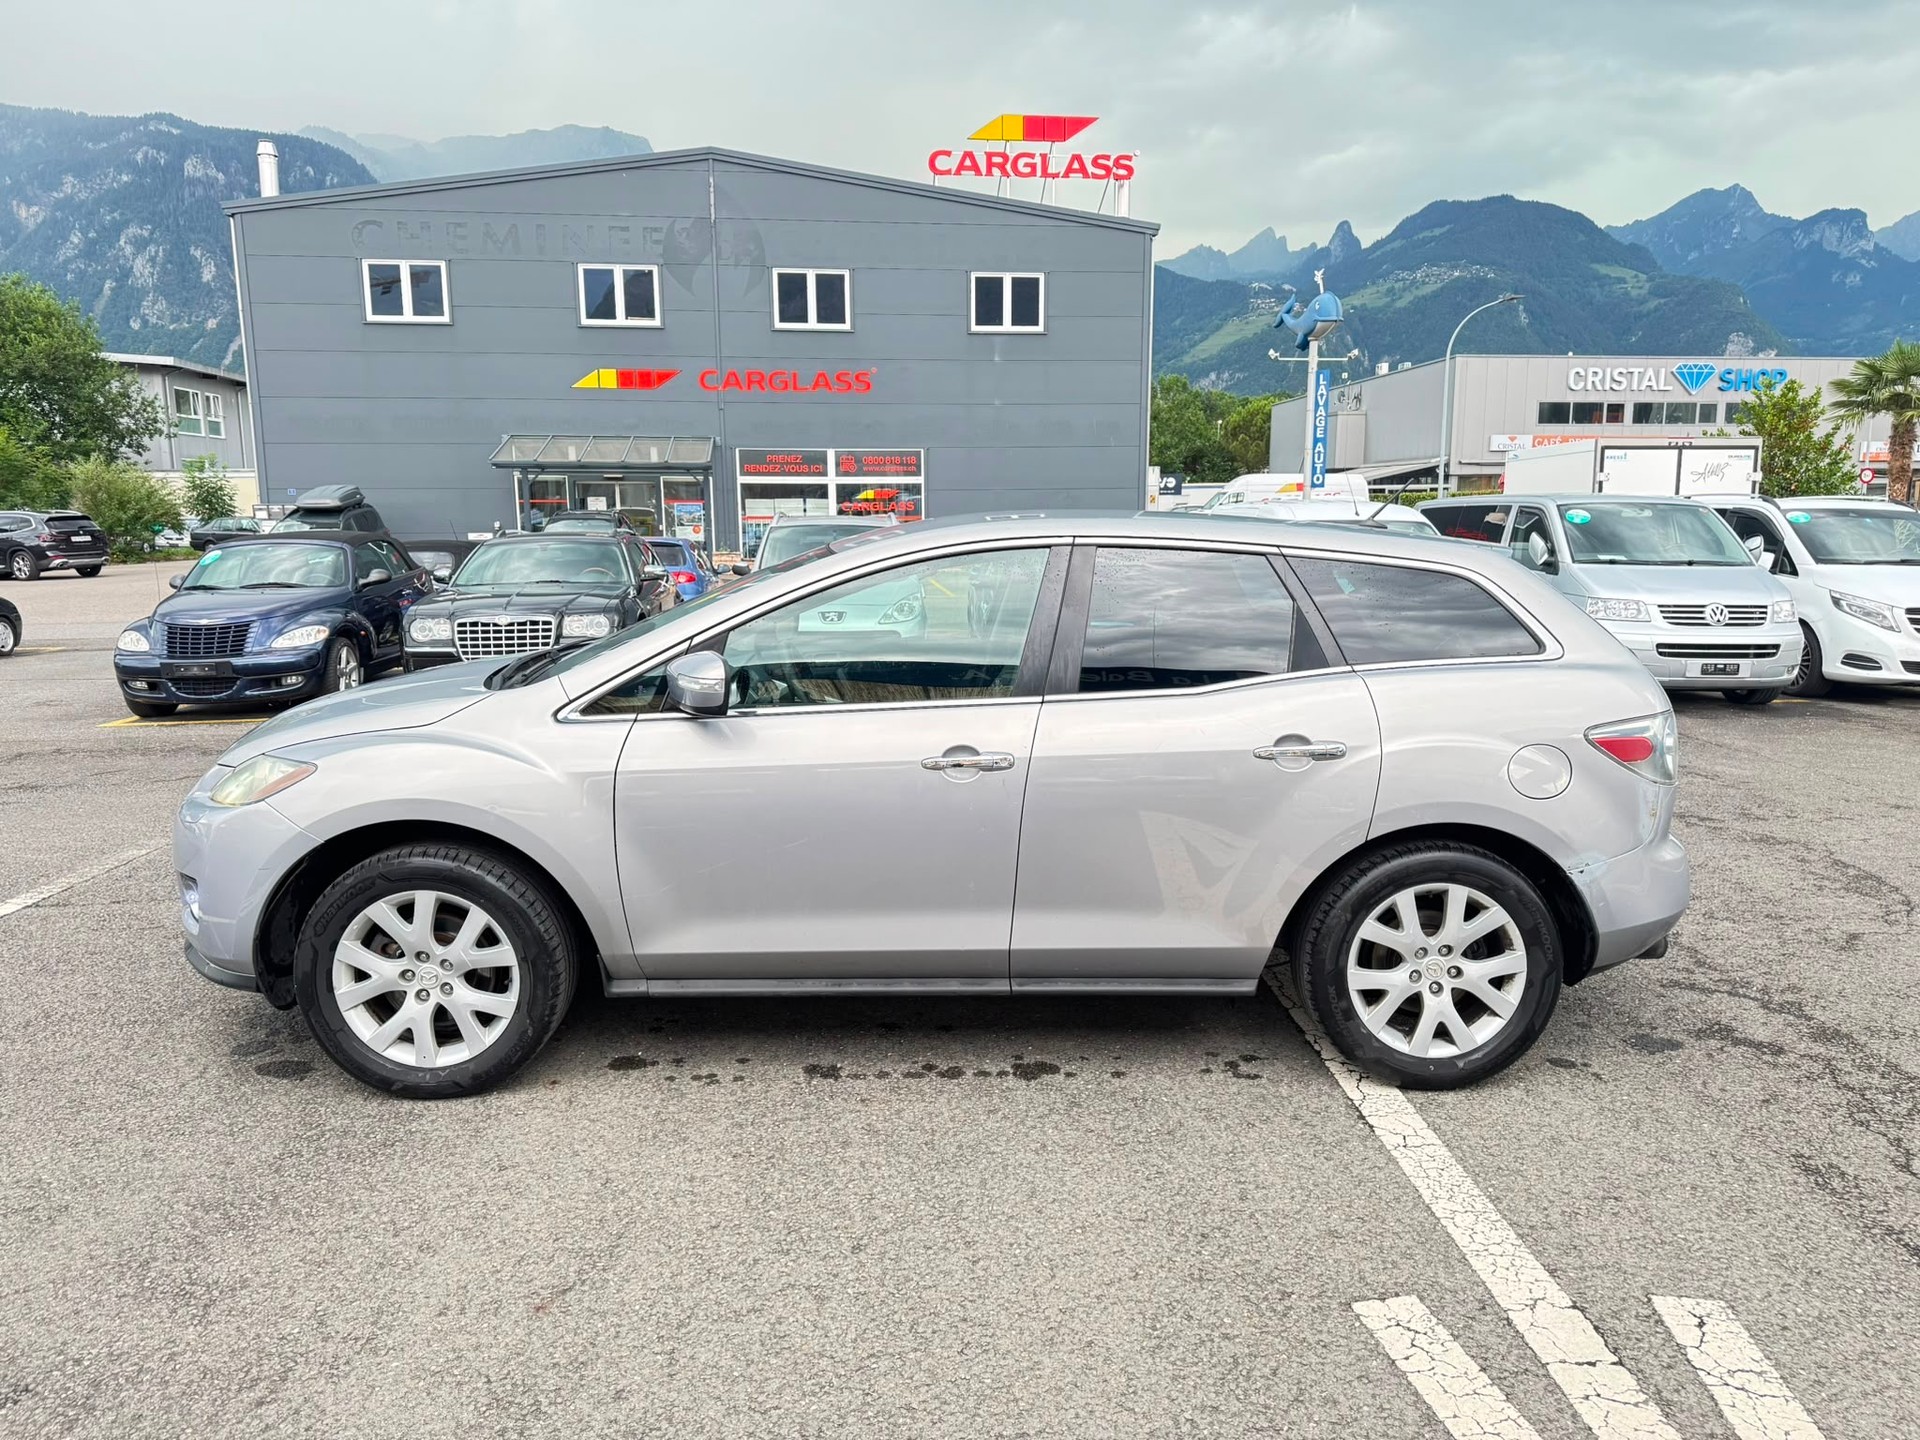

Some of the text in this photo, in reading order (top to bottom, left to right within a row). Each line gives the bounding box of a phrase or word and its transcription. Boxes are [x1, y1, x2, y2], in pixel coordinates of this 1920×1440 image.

[928, 149, 1134, 181] CARGLASS
[698, 369, 873, 394] CARGLASS
[1568, 367, 1788, 391] CRISTAL SHOP
[1312, 373, 1328, 484] LAVAGE AUTO
[766, 455, 802, 463] PRENEZ
[862, 456, 917, 464] 0800 818 118
[744, 464, 809, 473] RENDEZ-VOUS
[863, 465, 917, 473] www.carglass.ch
[841, 501, 915, 511] CARGLASS
